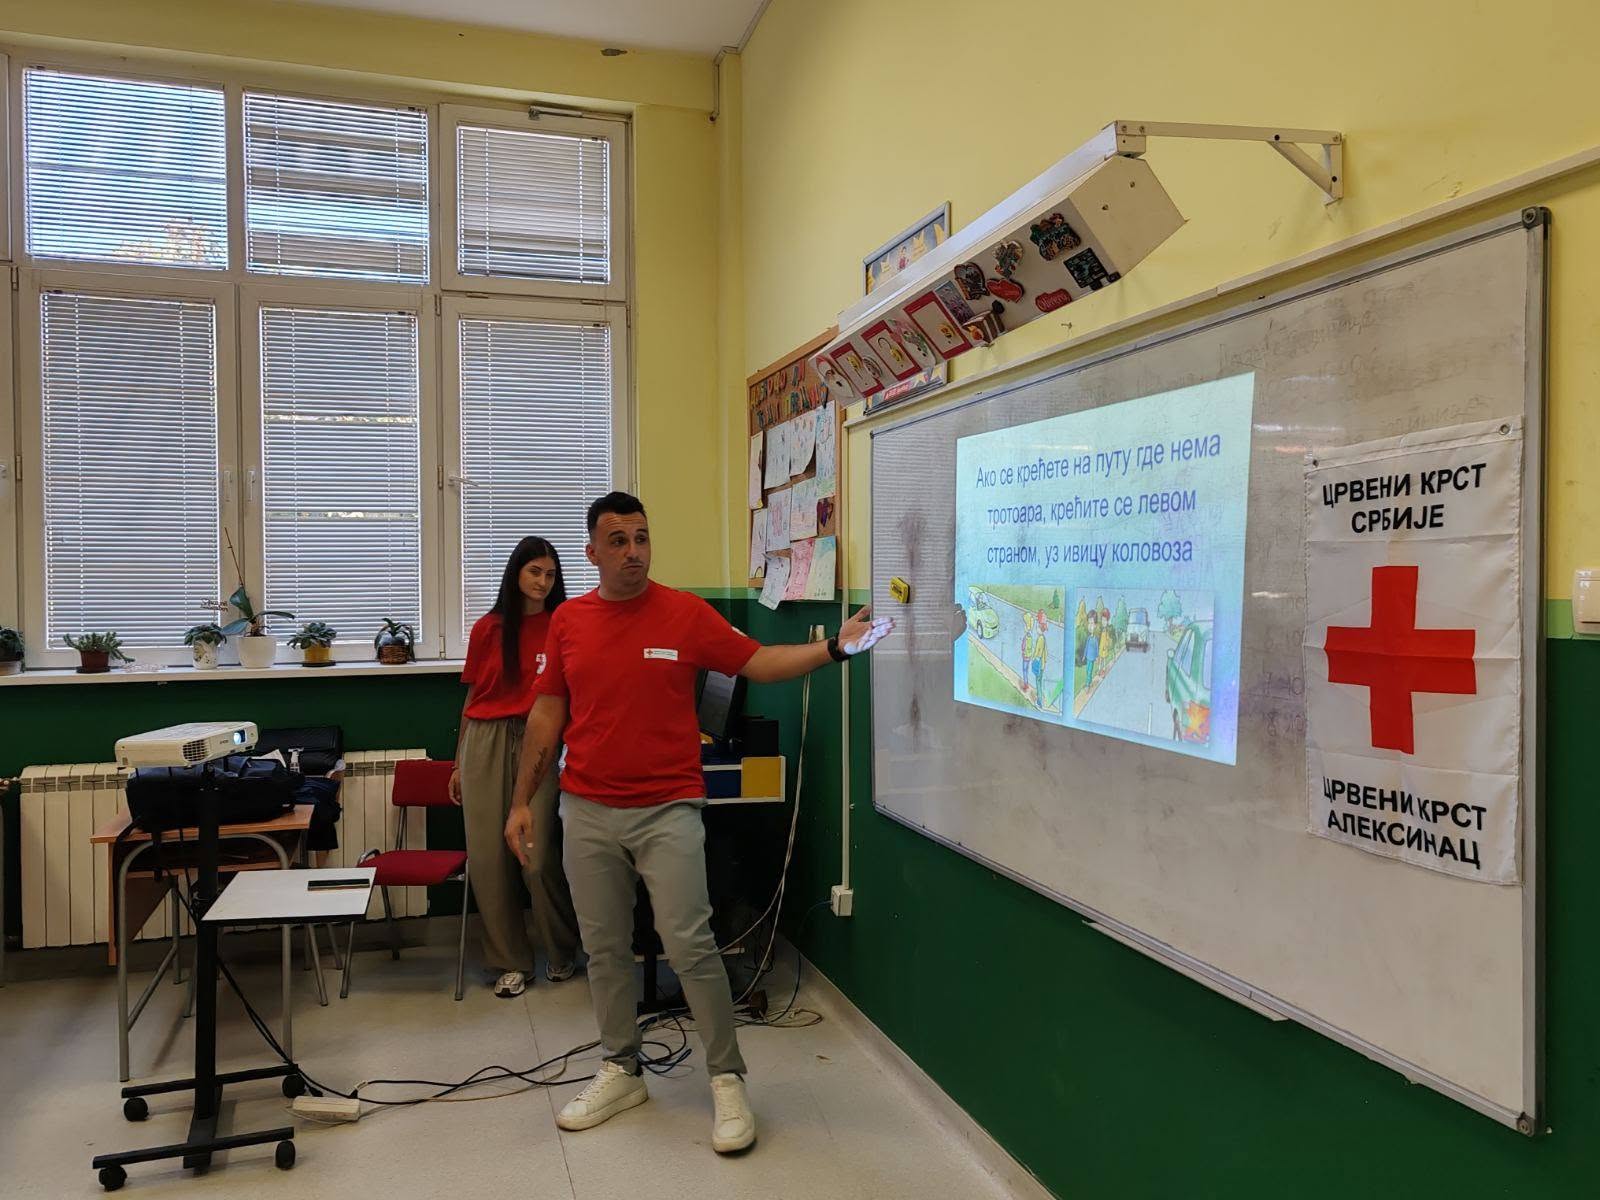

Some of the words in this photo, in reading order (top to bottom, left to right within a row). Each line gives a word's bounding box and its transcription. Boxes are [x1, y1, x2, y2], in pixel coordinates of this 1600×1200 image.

[976, 466, 996, 488] Ако
[999, 468, 1014, 486] се
[1017, 457, 1068, 488] крећете
[1074, 454, 1090, 476] на
[1096, 447, 1132, 478] путу
[1136, 446, 1164, 471] где
[1170, 434, 1221, 461] нема
[1322, 473, 1411, 508] ЦРВЕНИ
[1420, 463, 1486, 495] КРСТ
[988, 505, 1046, 530] тротоара,
[1050, 496, 1108, 522] крећите
[1114, 496, 1132, 516] се
[1138, 490, 1196, 514] левом
[1351, 504, 1445, 533] СРБИЈЕ
[987, 546, 1040, 568] страном,
[1044, 546, 1058, 568] уз
[1064, 543, 1107, 568] ивицу
[1112, 540, 1193, 563] коловоза
[1323, 776, 1414, 816] ЦРВЕНИ
[1417, 797, 1486, 830] КРСТ
[1328, 809, 1481, 870] АЛЕКСИНАЦ
